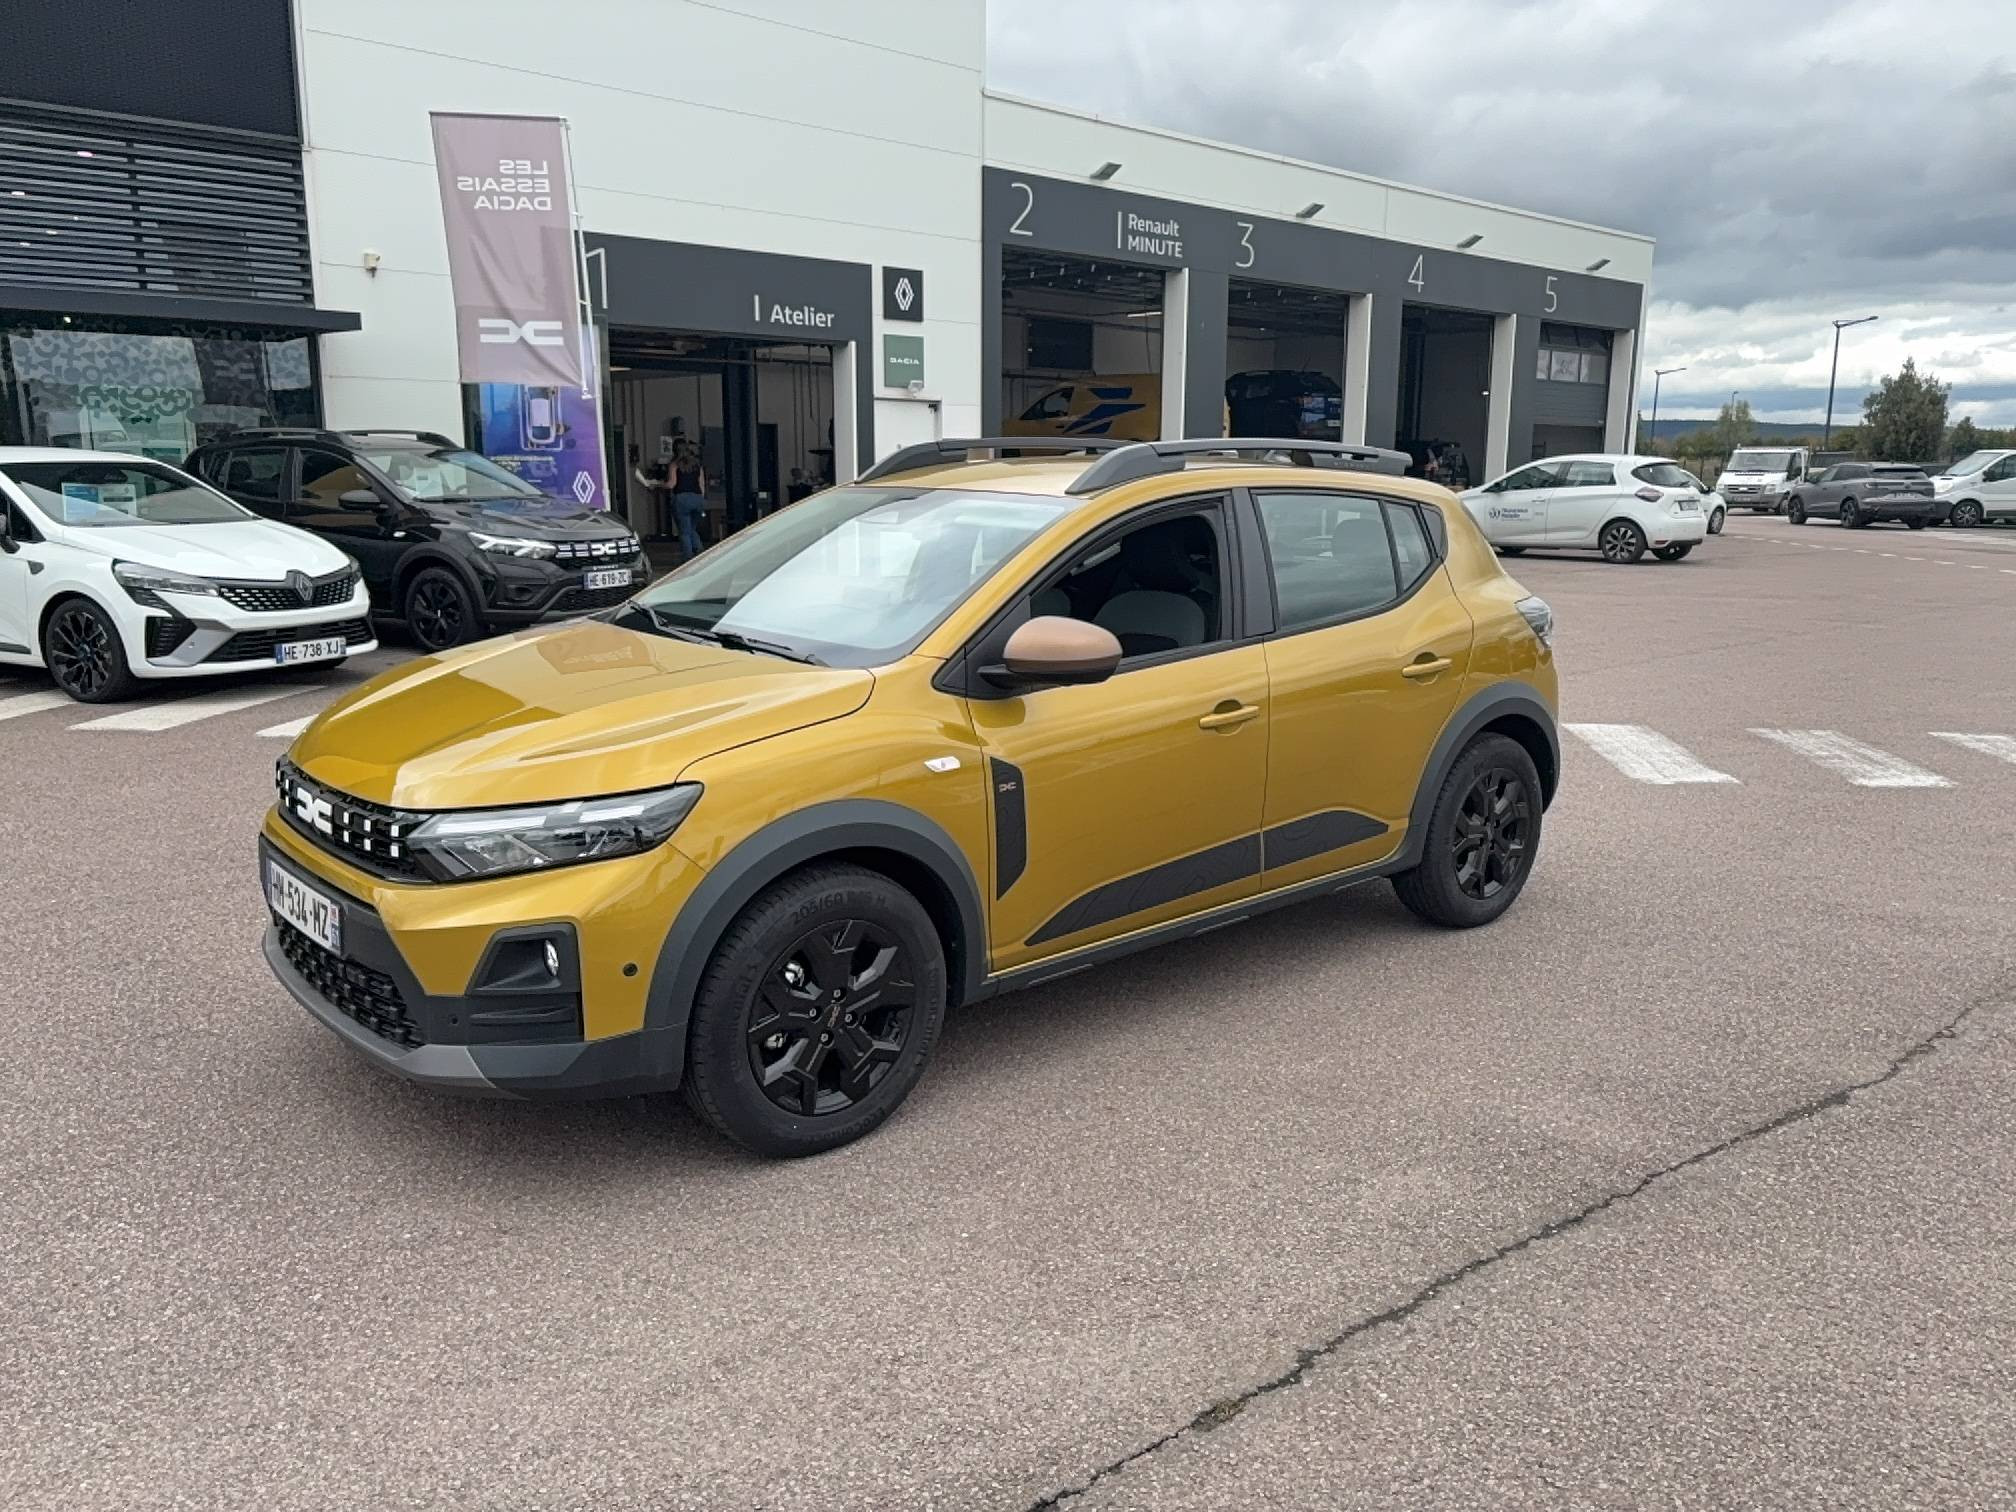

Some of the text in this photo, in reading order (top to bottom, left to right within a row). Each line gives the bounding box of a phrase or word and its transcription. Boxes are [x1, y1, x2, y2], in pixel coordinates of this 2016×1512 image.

[1009, 183, 1034, 237] 2
[1127, 213, 1180, 237] Renault
[1127, 234, 1183, 258] MINUTE
[1235, 221, 1255, 268] 3
[1407, 254, 1425, 293] 4
[1544, 275, 1558, 313] 5
[770, 303, 835, 328] Atelier
